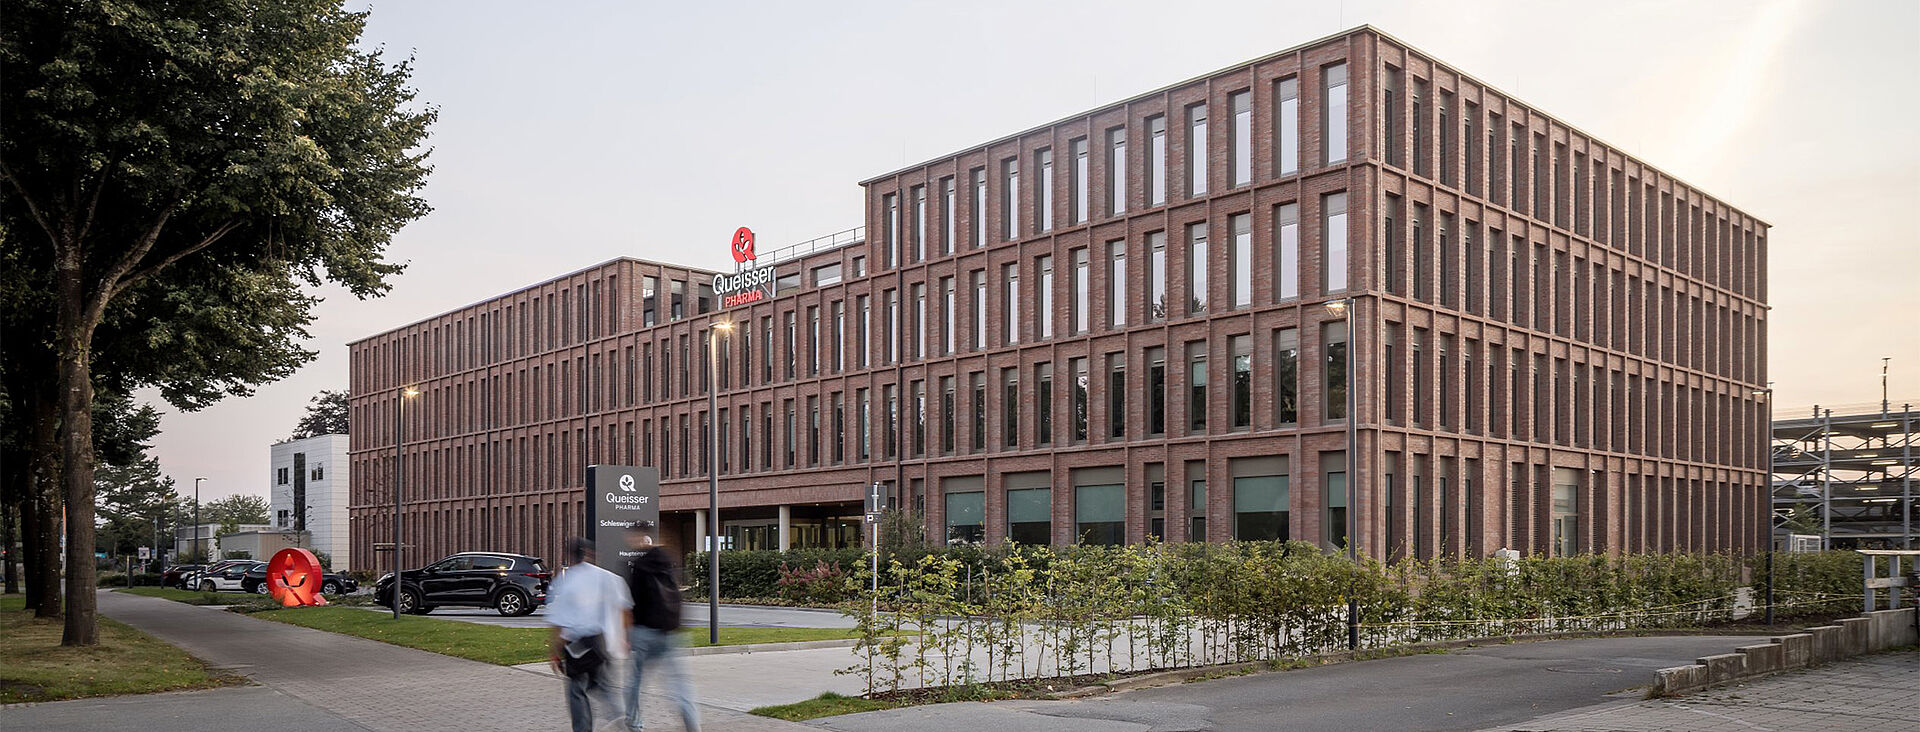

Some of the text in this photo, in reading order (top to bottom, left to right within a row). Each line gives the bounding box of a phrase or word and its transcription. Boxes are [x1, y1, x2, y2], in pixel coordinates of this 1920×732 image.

[713, 266, 775, 295] Queisser
[725, 289, 762, 308] PHARMA
[606, 492, 649, 504] Queisser
[600, 519, 635, 528] Schleswiger
